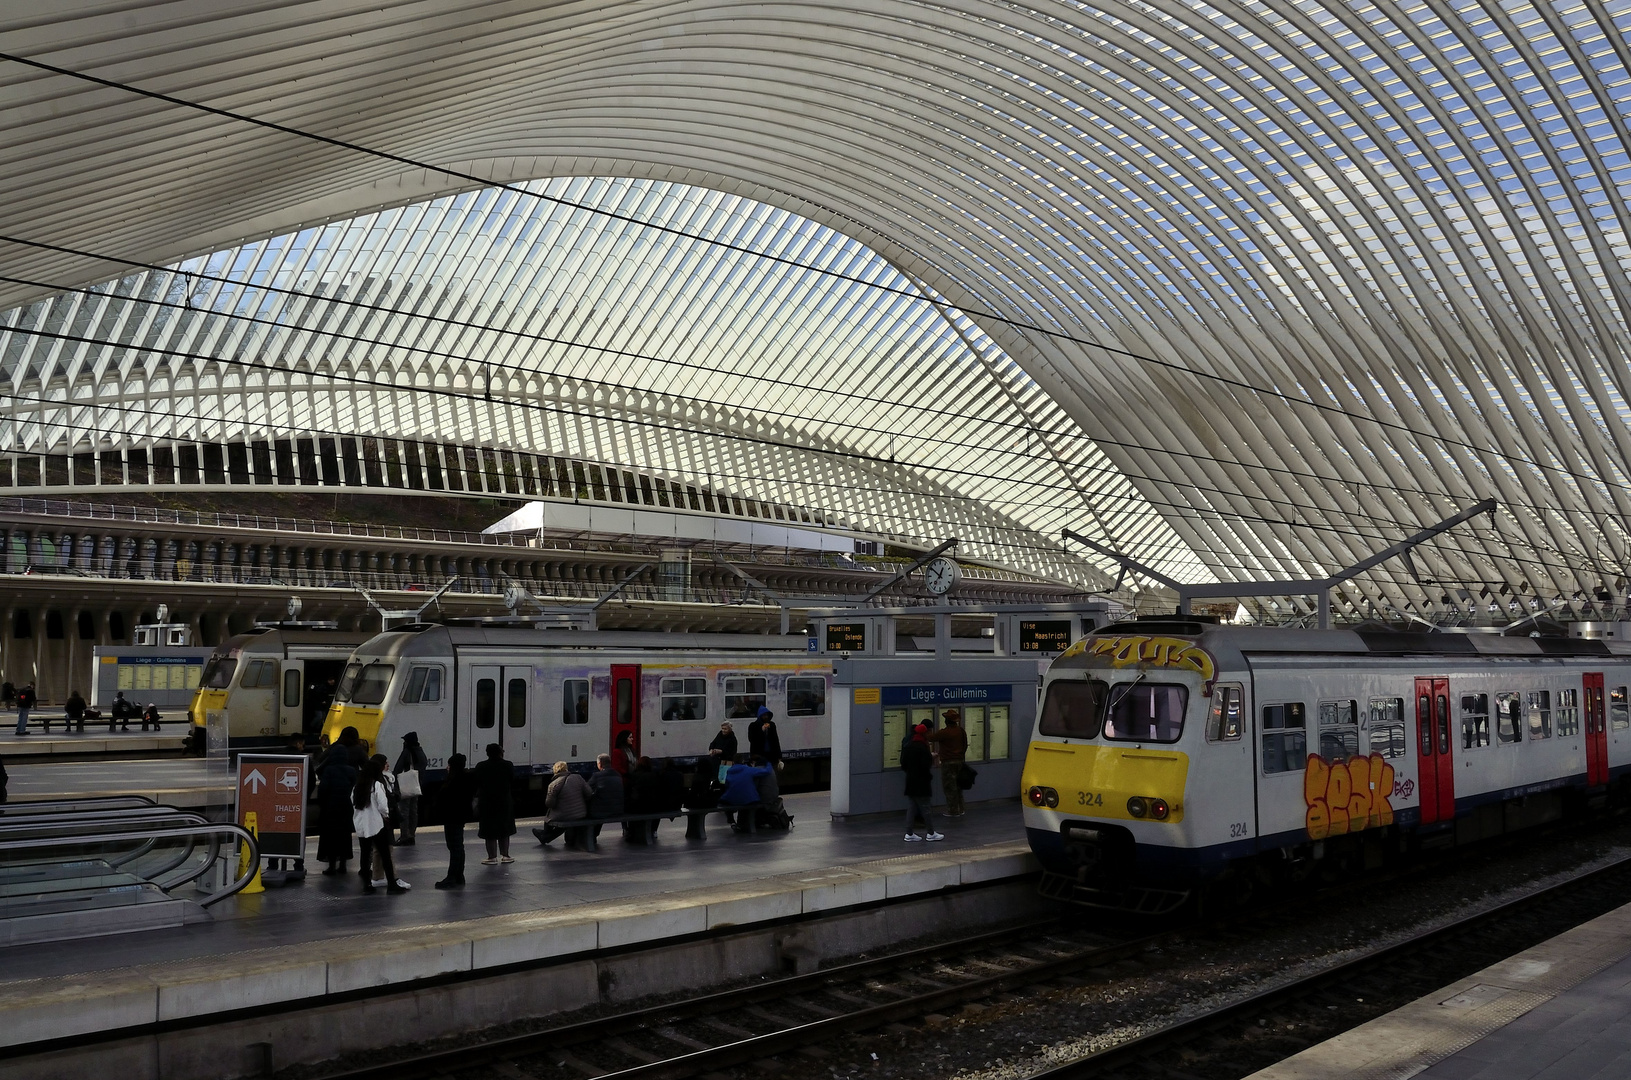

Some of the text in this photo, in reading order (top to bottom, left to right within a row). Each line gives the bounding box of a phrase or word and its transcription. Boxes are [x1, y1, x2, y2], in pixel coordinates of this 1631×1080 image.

[910, 688, 935, 702] Liège
[943, 688, 988, 699] Guillemins
[1360, 711, 1367, 731] 2
[1078, 792, 1103, 807] 324
[1230, 823, 1247, 837] 324
